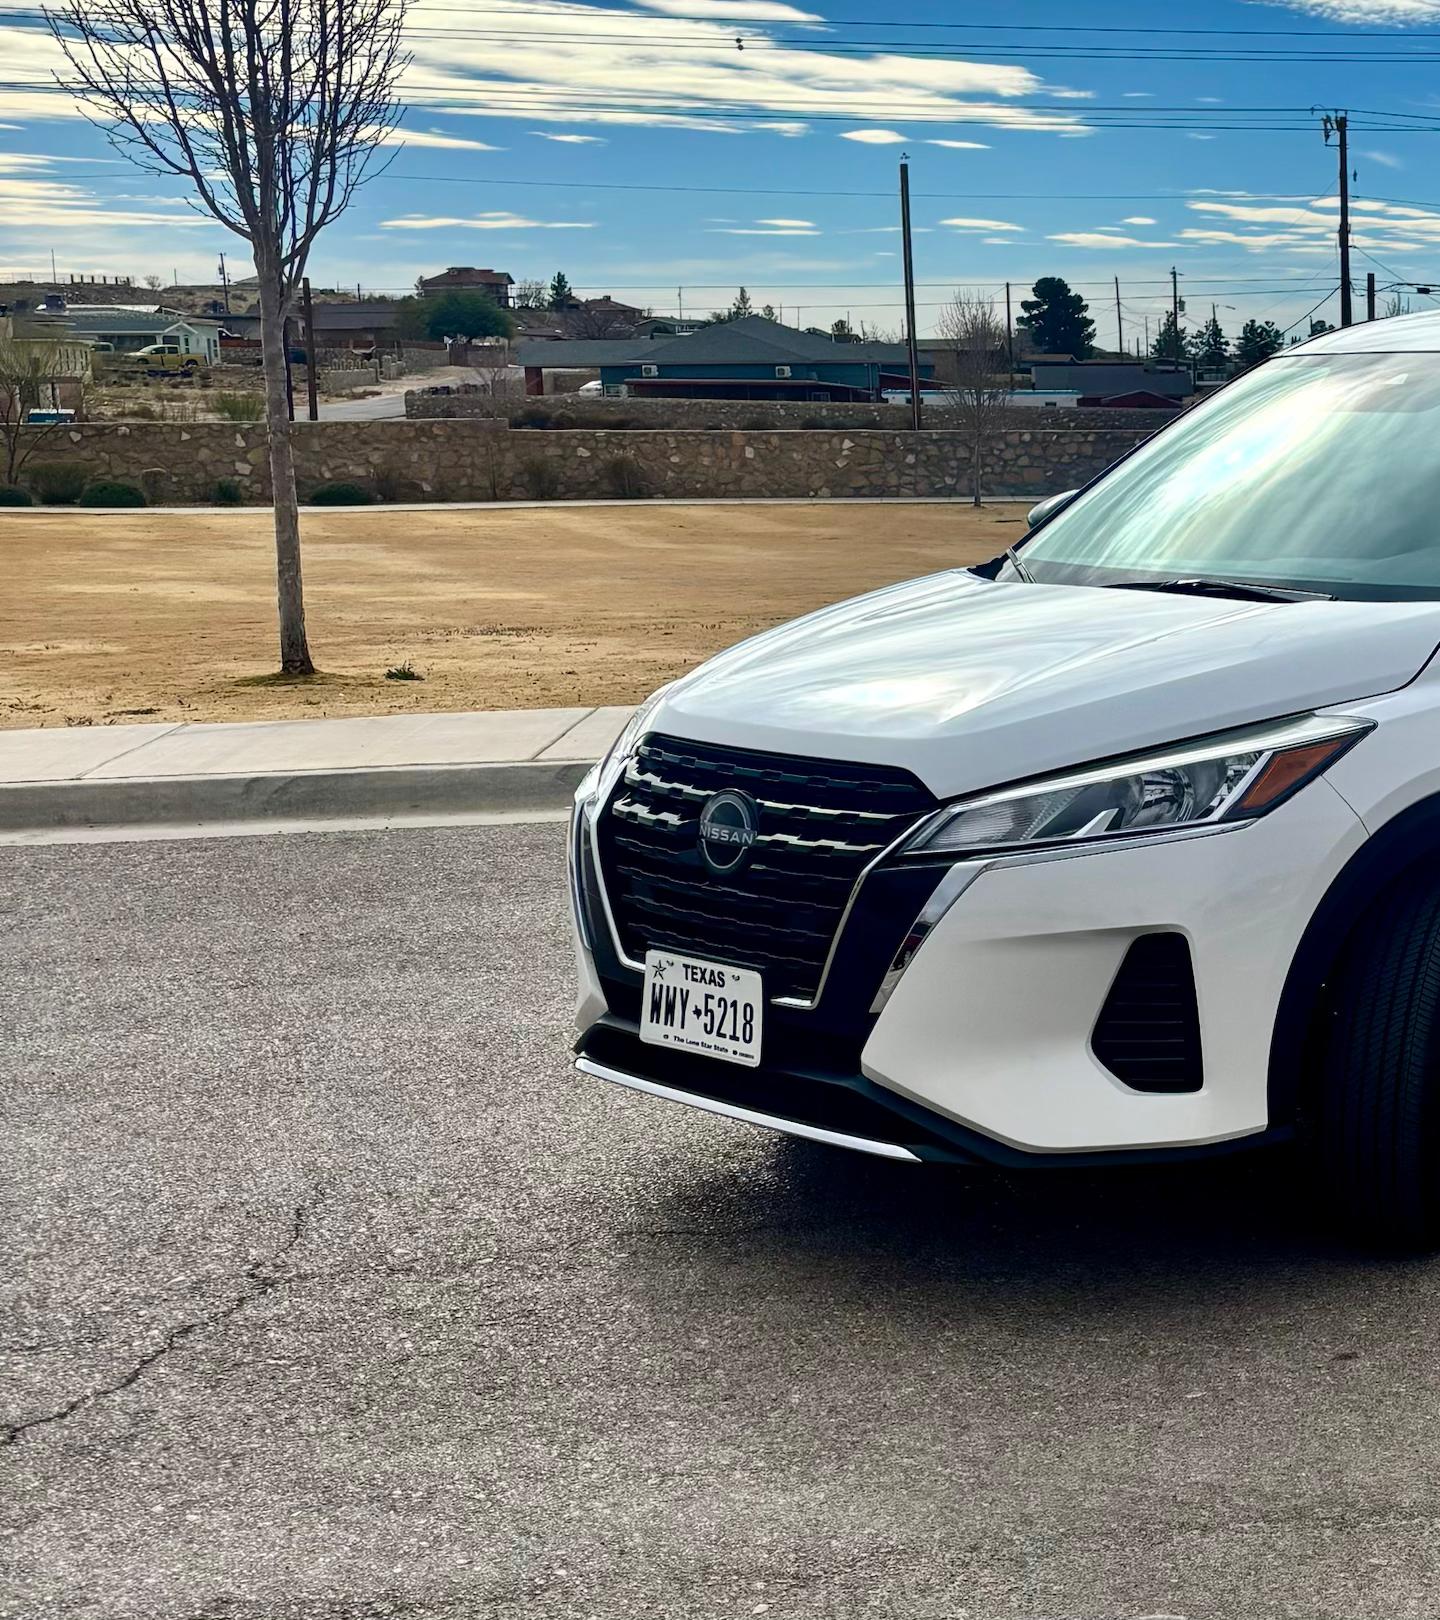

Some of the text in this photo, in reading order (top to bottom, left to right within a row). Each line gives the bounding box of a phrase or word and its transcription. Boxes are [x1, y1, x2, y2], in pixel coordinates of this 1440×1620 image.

[699, 824, 754, 845] NISSAN
[682, 963, 725, 988] TEXAS
[703, 993, 754, 1044] 5218
[674, 1035, 728, 1053] The Lone Star State
